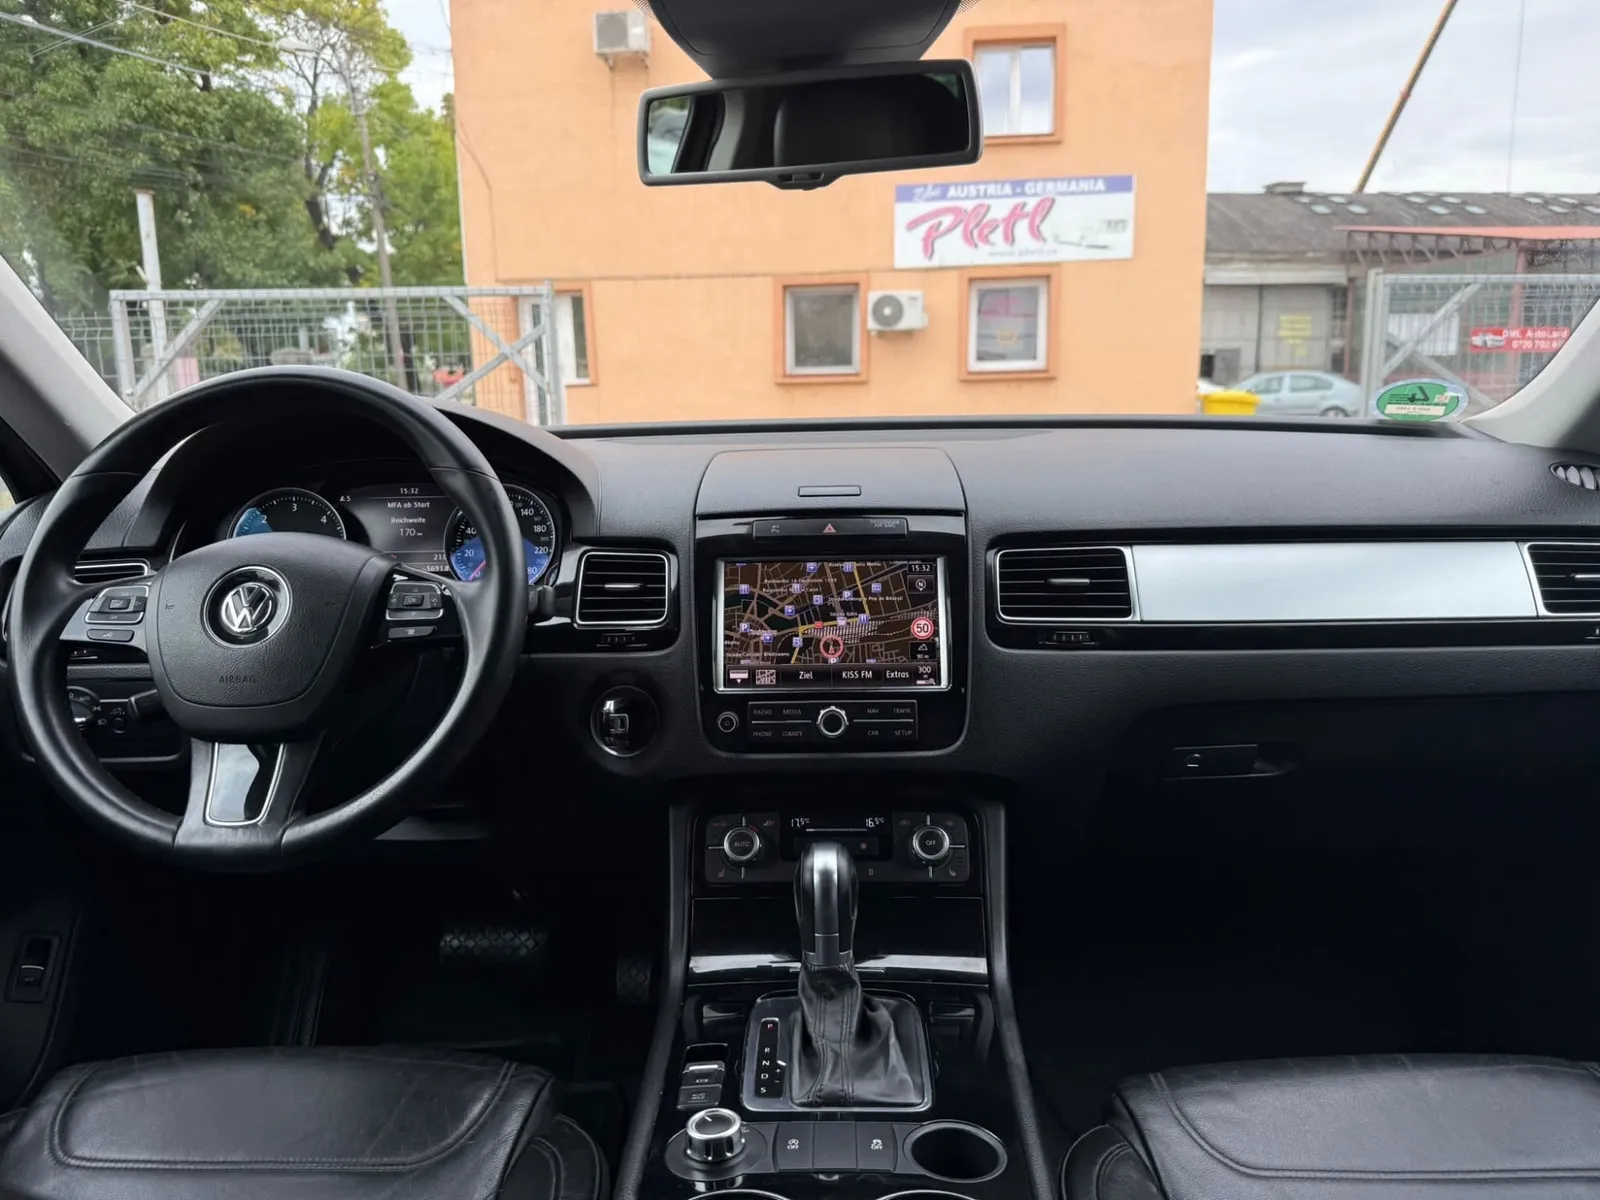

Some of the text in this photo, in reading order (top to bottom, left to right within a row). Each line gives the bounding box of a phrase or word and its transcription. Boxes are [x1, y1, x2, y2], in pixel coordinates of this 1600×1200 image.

[946, 183, 1010, 199] AUSTRIA
[1025, 178, 1106, 194] GERMANIA
[905, 196, 1056, 261] Pletl
[291, 503, 298, 512] 3
[520, 508, 535, 516] 140
[260, 515, 268, 524] 2
[320, 515, 328, 524] 4
[390, 516, 426, 524] Reichweite
[399, 527, 416, 536] 170
[533, 524, 547, 533] 180
[464, 549, 475, 557] 20
[534, 546, 549, 554] 220
[911, 564, 931, 572] 15:32
[915, 622, 930, 633] 50
[918, 665, 932, 674] 300
[799, 671, 813, 680] Ziel
[842, 670, 873, 679] KISS FM
[886, 670, 910, 679] Extras
[733, 840, 750, 848] AUTO
[760, 1086, 767, 1094] S
